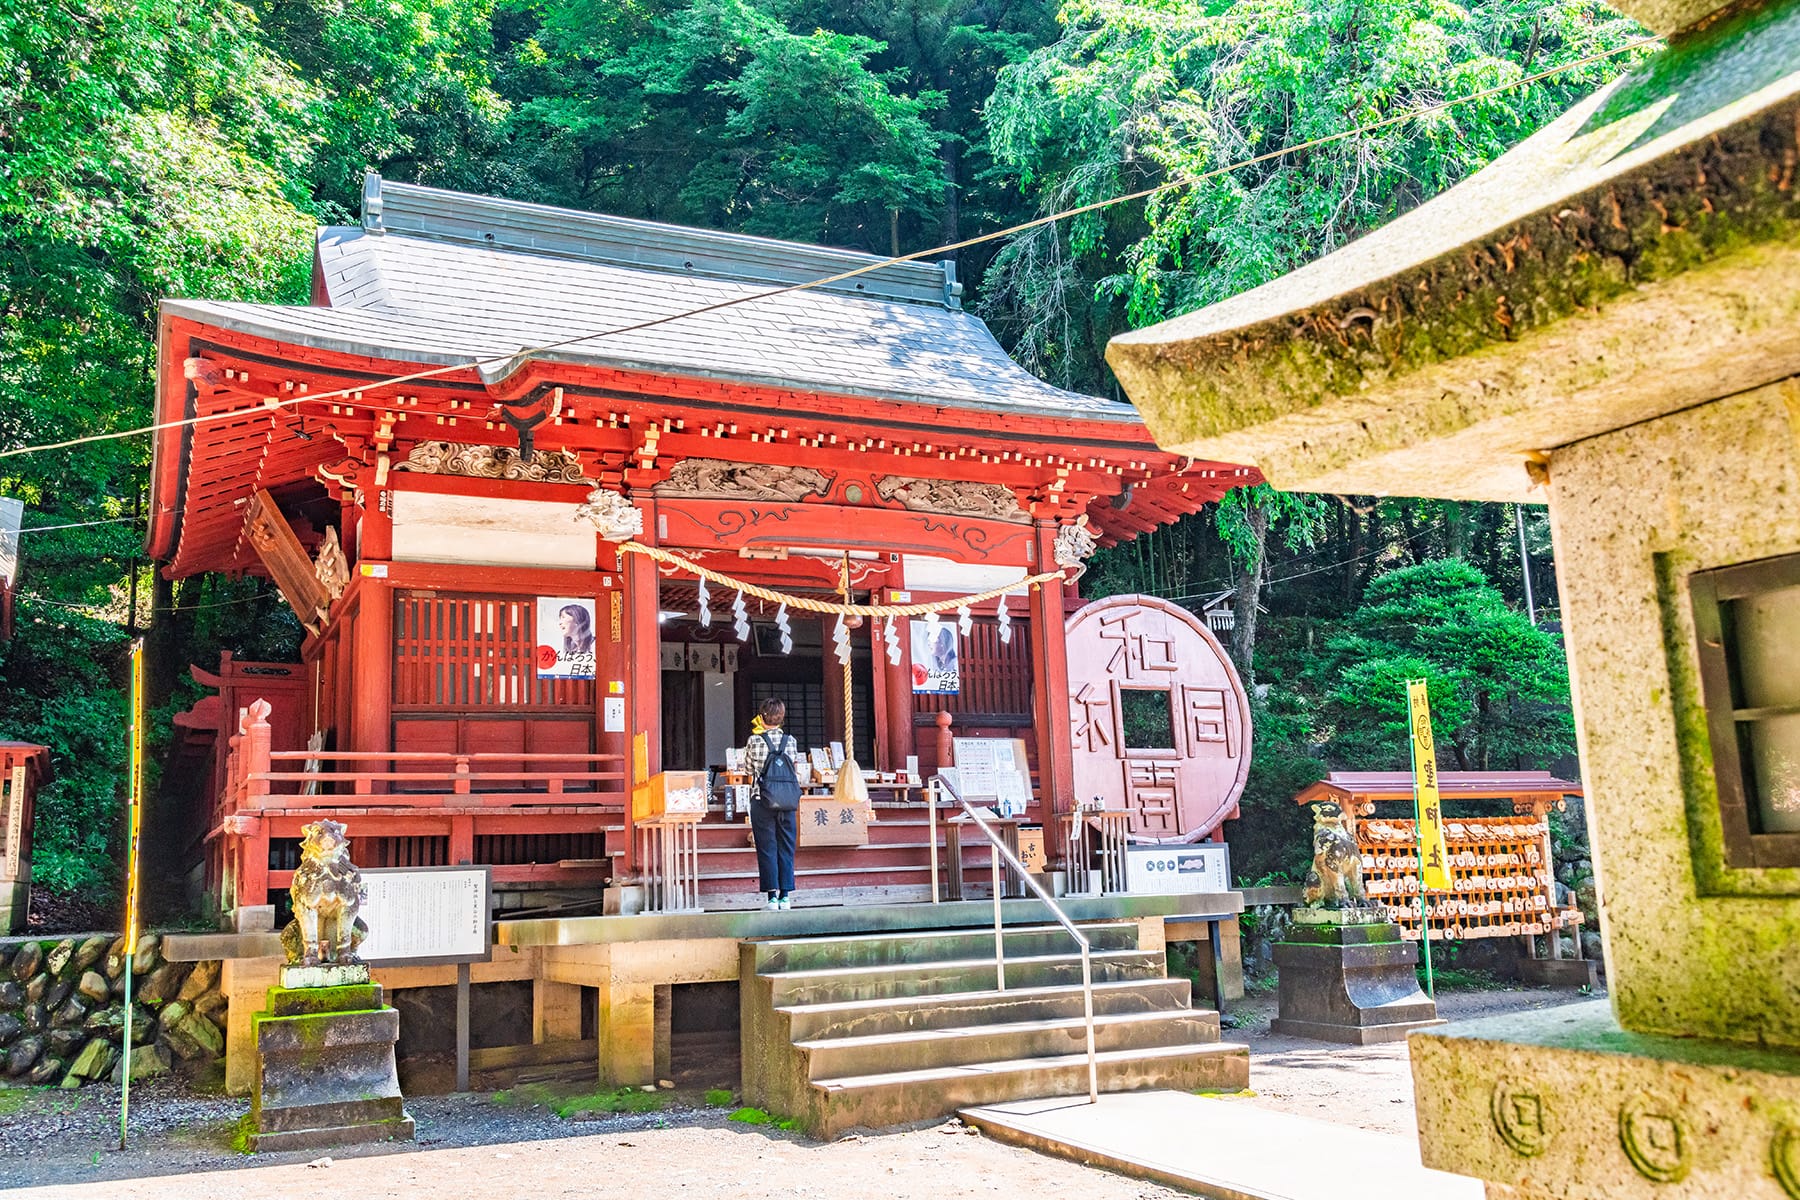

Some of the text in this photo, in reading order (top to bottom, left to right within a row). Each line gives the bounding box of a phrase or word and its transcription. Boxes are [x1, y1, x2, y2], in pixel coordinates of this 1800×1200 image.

[1100, 606, 1178, 679] 和
[1181, 683, 1237, 758] 同
[1028, 843, 1036, 858] 古い
